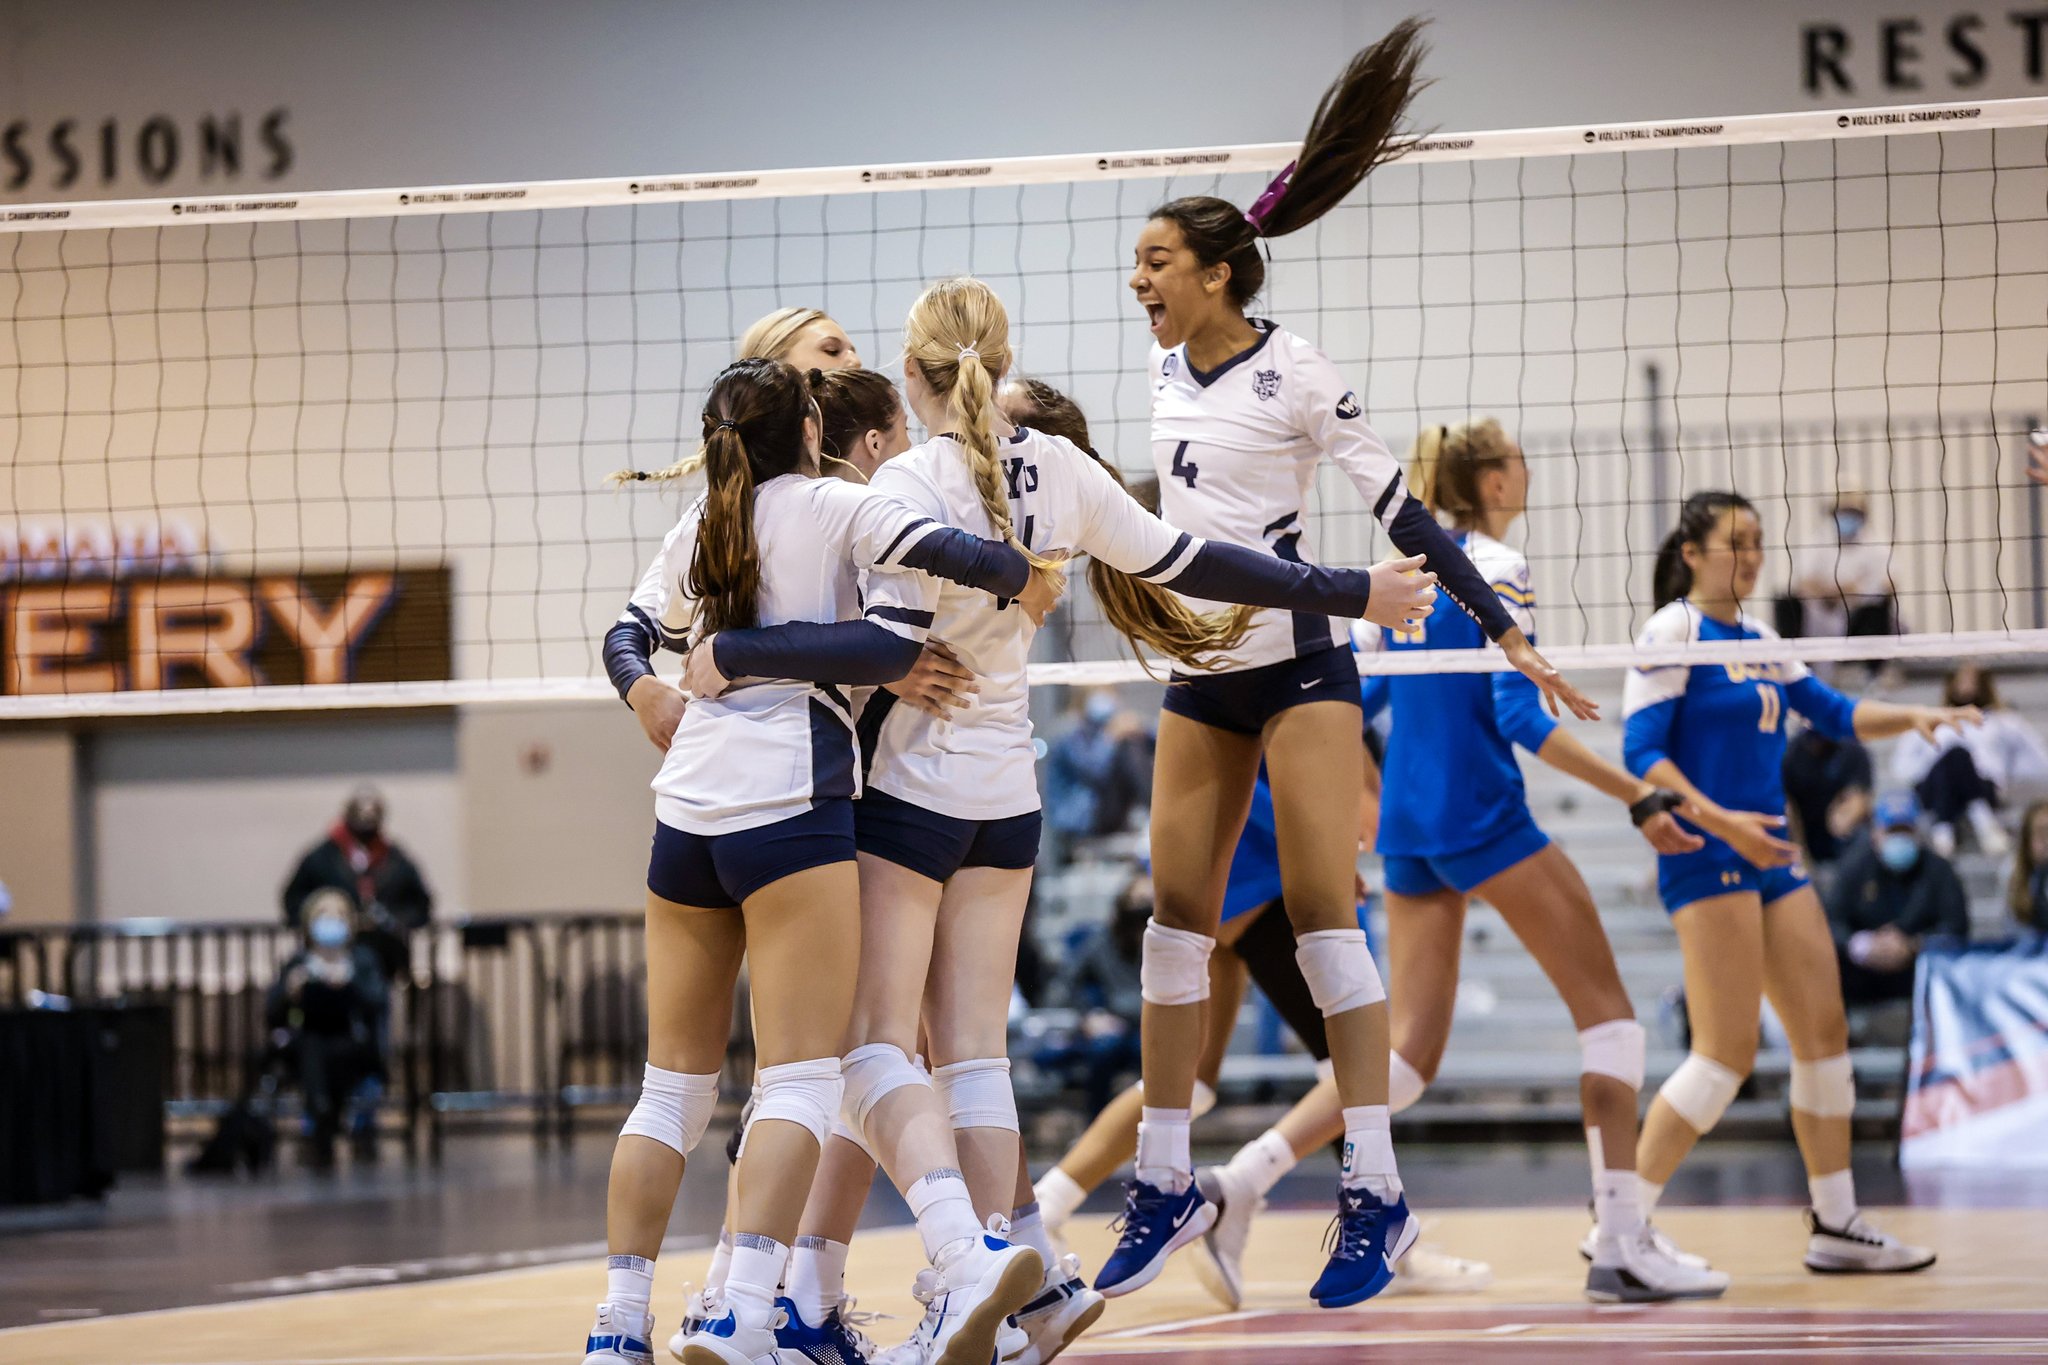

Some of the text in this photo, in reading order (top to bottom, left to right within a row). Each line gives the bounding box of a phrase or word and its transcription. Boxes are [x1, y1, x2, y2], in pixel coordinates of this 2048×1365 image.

[1801, 9, 2048, 96] REST
[1598, 124, 1725, 142] VOLLEYBALL CHAMPIONSHIP
[1851, 108, 1983, 126] VOLLEYBALL CHAMPIONSHIP
[1, 104, 292, 192] SSIONS
[1409, 139, 1475, 152] HAMPIONSHIP
[1001, 457, 1039, 500] YU
[1172, 440, 1199, 488] 4
[8, 572, 398, 693] ERY
